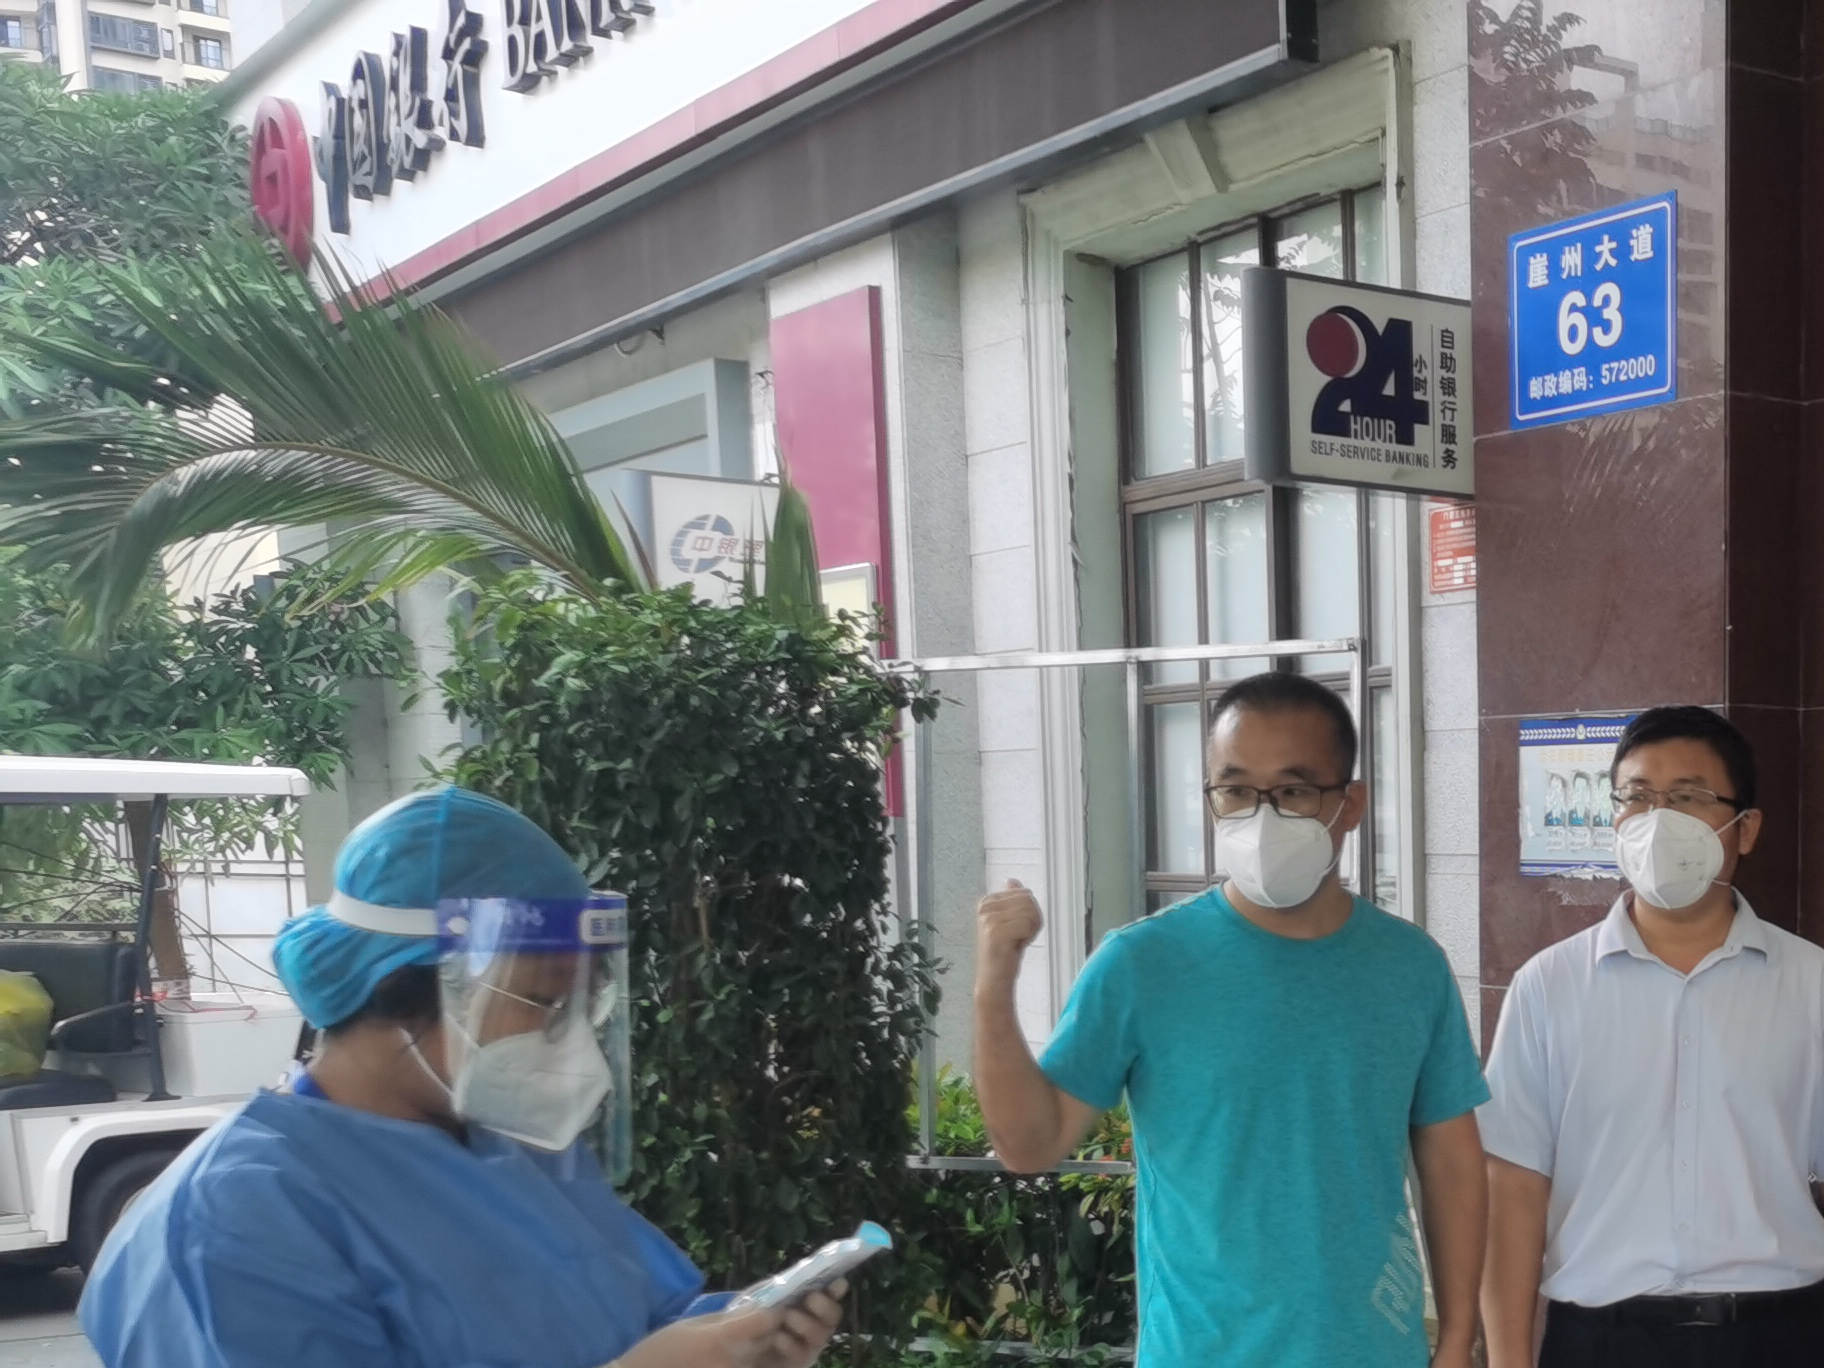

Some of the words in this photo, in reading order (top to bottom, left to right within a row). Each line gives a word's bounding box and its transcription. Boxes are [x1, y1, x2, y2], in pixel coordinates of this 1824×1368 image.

[1527, 223, 1655, 288] 崖州大道
[1558, 281, 1623, 355] 63
[1306, 305, 1430, 446] 24
[1414, 353, 1429, 396] 小时
[1439, 327, 1458, 470] 自助银行服务
[1311, 439, 1382, 463] SELF-SERVICE
[1385, 450, 1430, 469] BANKING
[1350, 414, 1397, 444] HOUR
